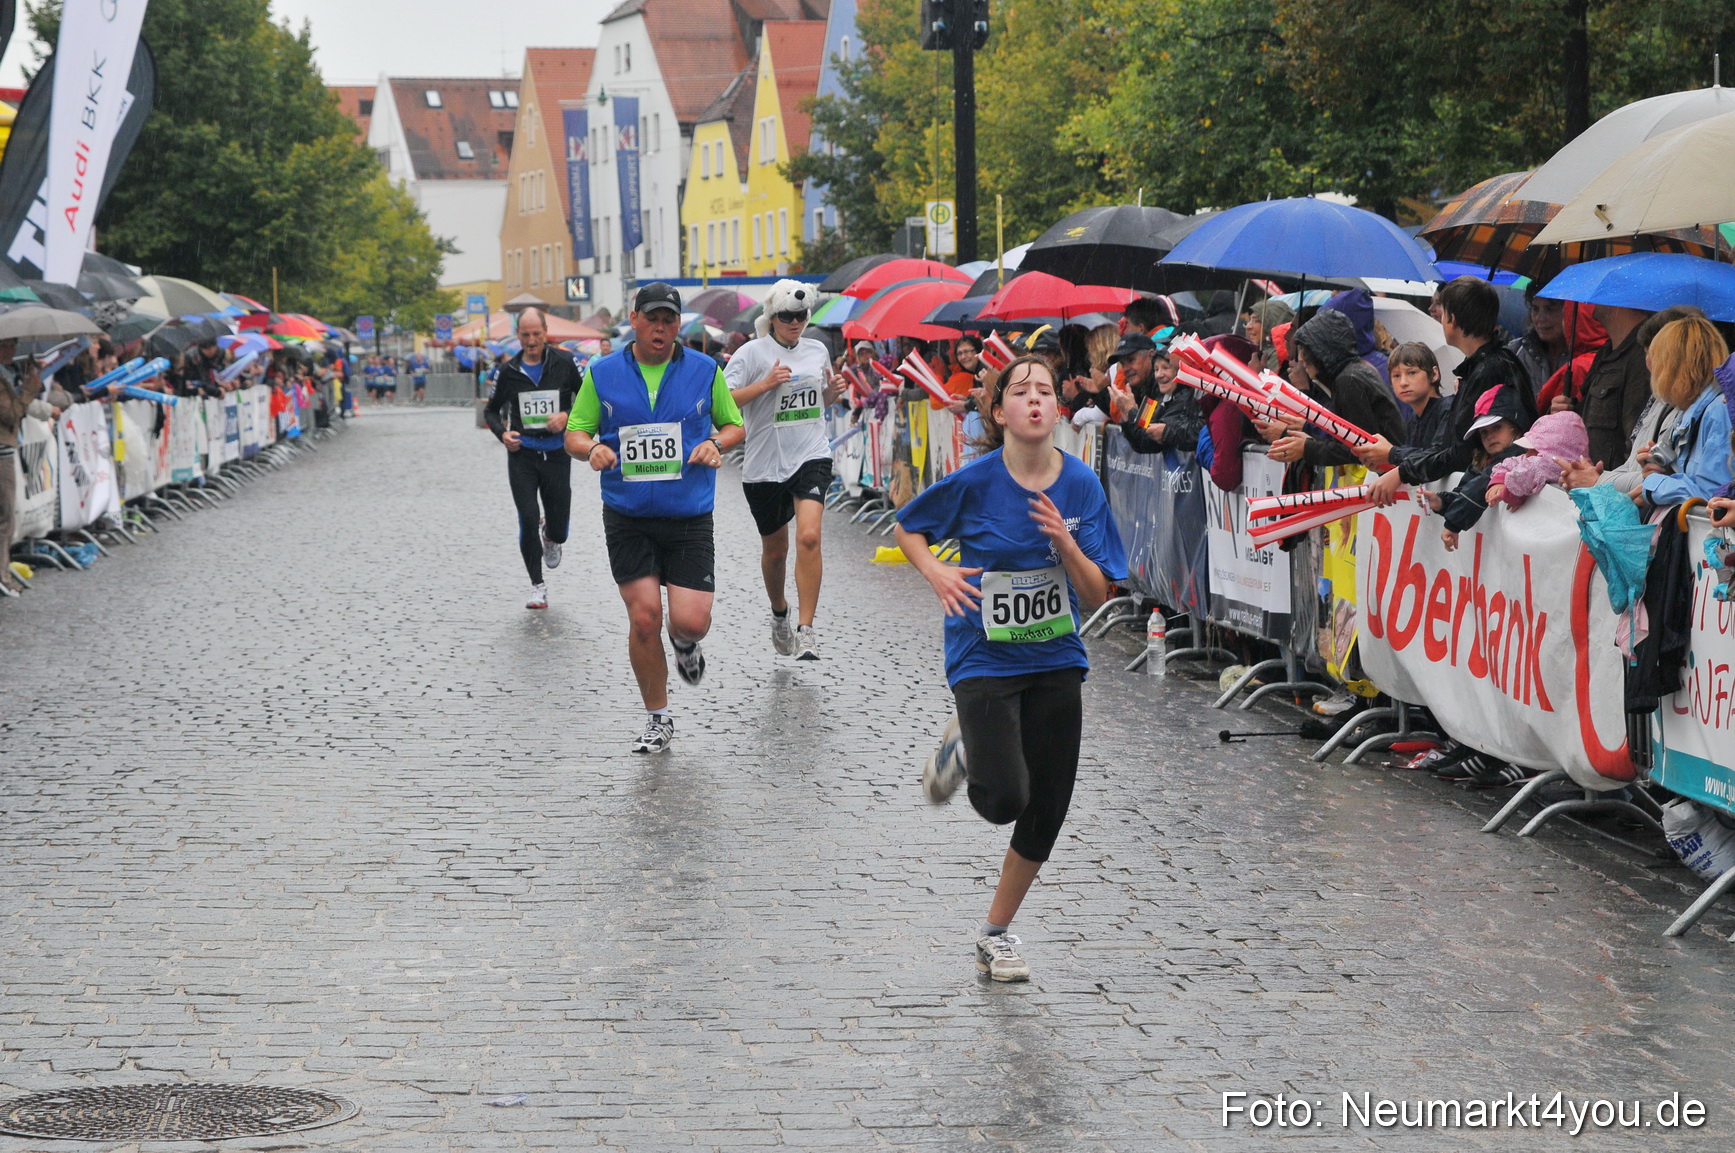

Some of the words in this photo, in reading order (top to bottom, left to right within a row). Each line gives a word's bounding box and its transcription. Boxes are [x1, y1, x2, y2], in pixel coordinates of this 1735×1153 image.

[64, 139, 91, 233] Audi
[82, 48, 107, 131] BKK
[523, 400, 555, 415] 5131
[780, 389, 817, 410] 5210
[626, 437, 677, 461] 5158
[635, 463, 668, 473] Michael
[1276, 484, 1368, 510] USTRIA
[992, 583, 1062, 626] 5066
[1366, 511, 1555, 713] Oberbank
[1009, 625, 1055, 641] Barbara
